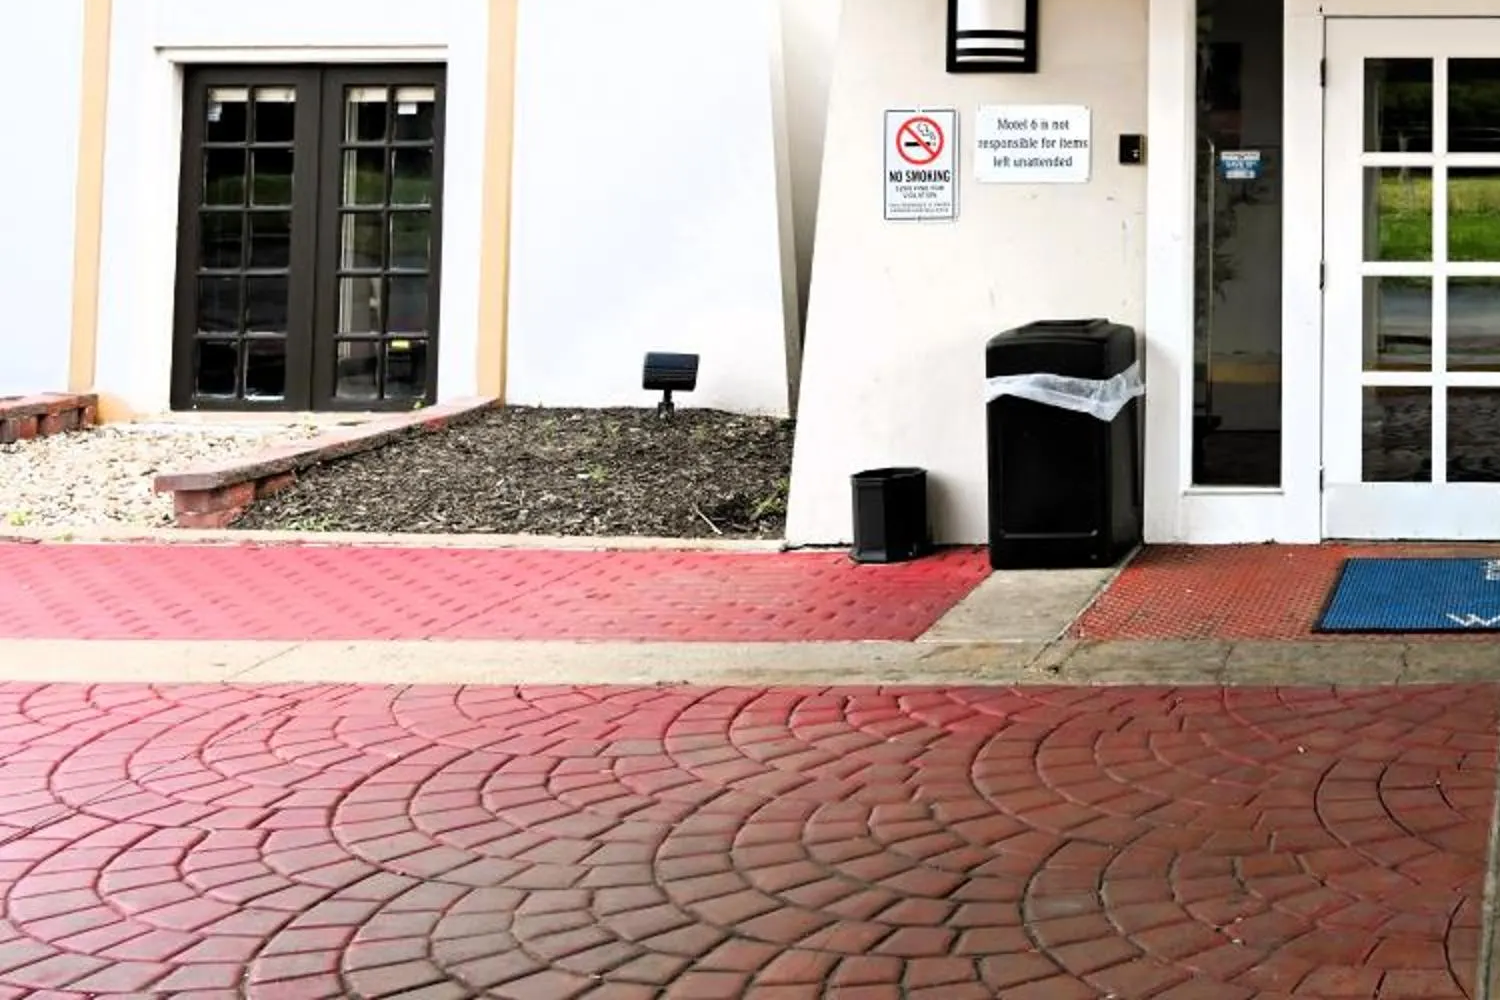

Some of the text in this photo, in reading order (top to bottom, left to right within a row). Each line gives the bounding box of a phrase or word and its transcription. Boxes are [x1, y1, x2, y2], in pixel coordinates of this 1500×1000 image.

[997, 117, 1069, 130] Motel 6 is not
[977, 137, 1038, 151] responsible
[1041, 137, 1056, 149] for
[993, 155, 1072, 167] left unattended
[889, 169, 951, 182] NO SMOKING
